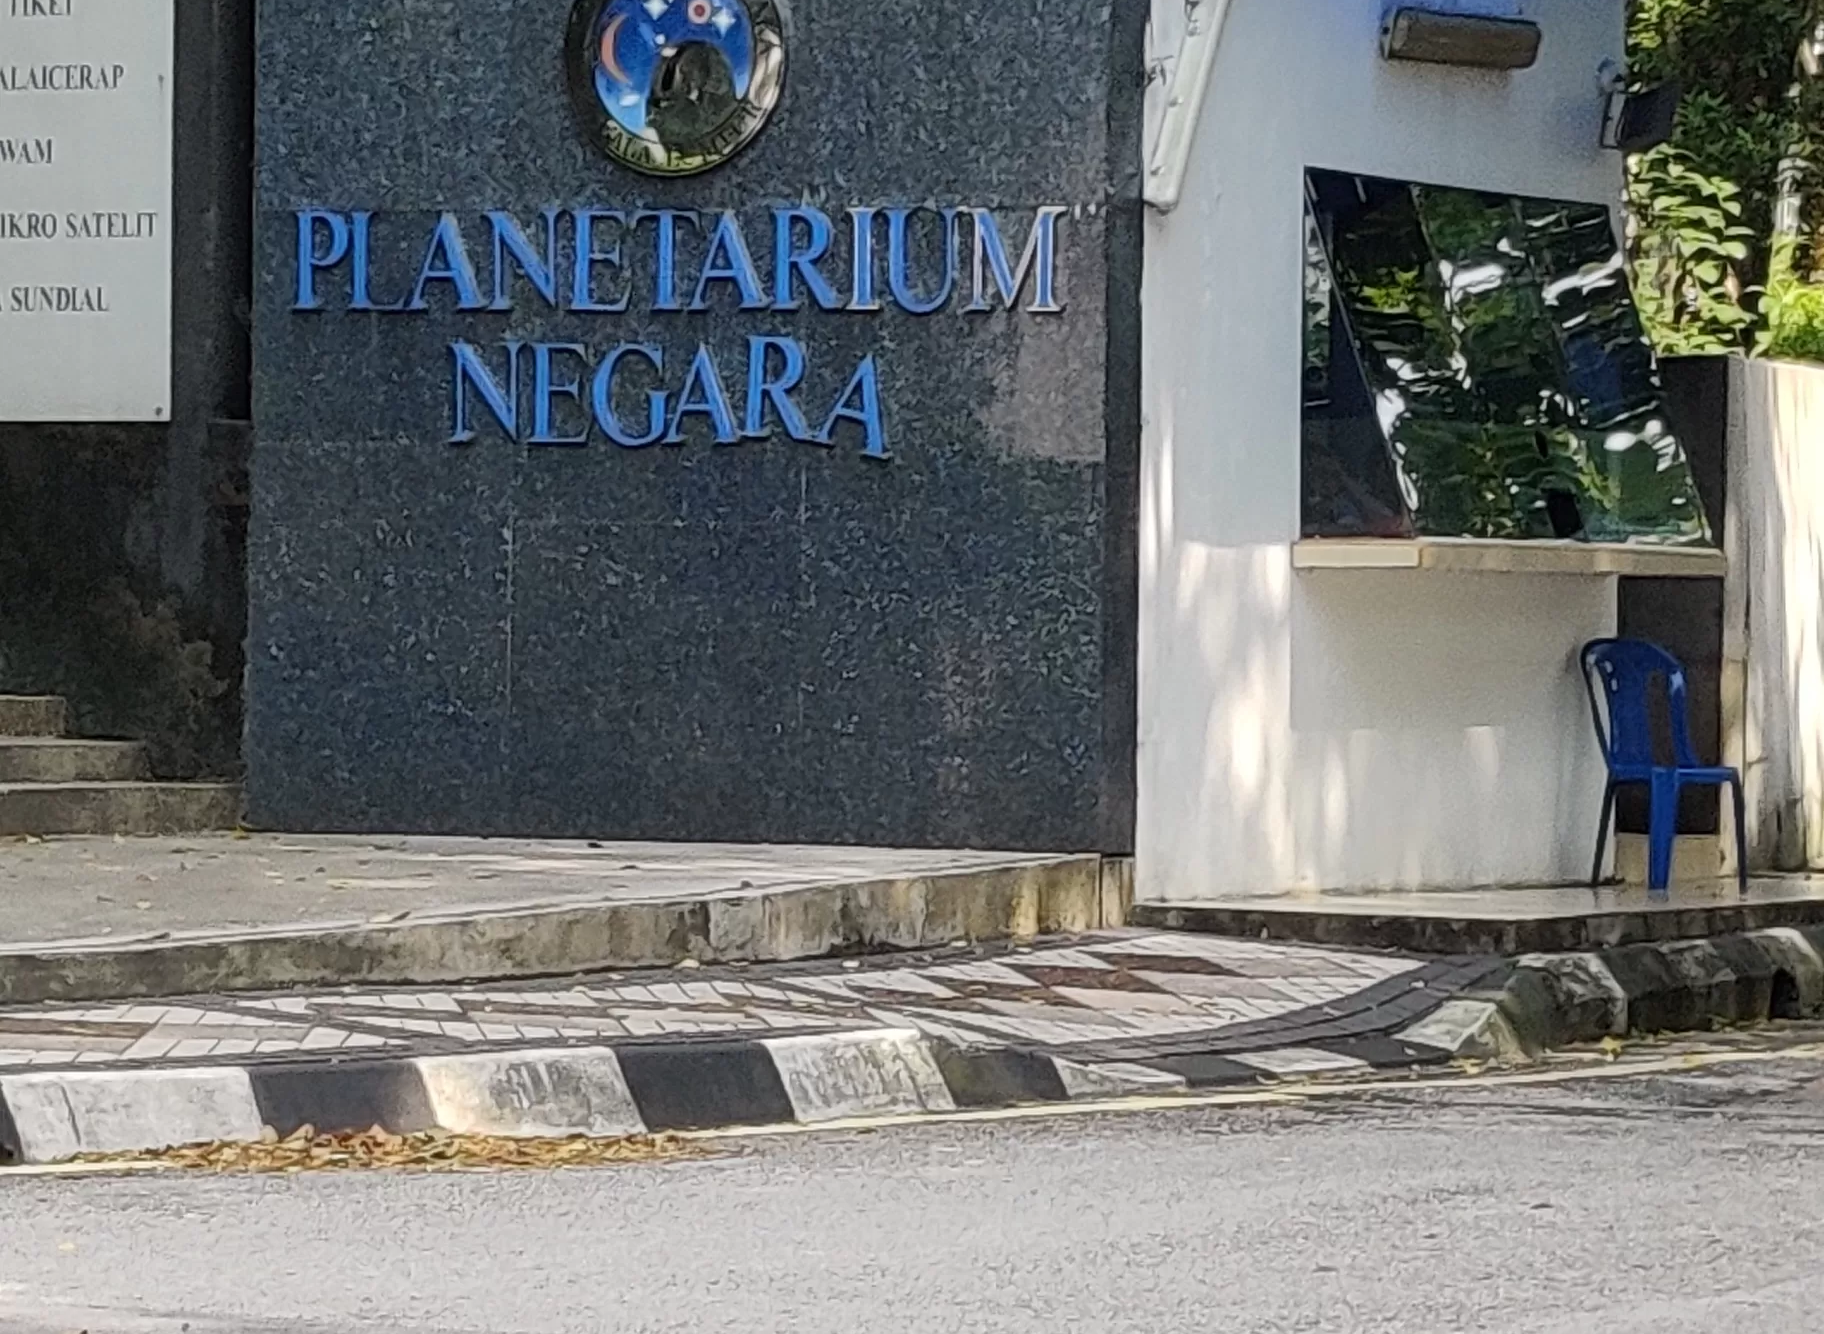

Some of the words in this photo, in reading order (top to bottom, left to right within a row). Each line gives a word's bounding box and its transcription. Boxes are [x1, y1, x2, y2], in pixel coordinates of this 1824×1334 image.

[65, 211, 158, 238] SATELIT
[292, 205, 1068, 313] PLANETARIUM
[10, 286, 110, 312] SUNDIAL
[448, 335, 891, 461] NEGARA
